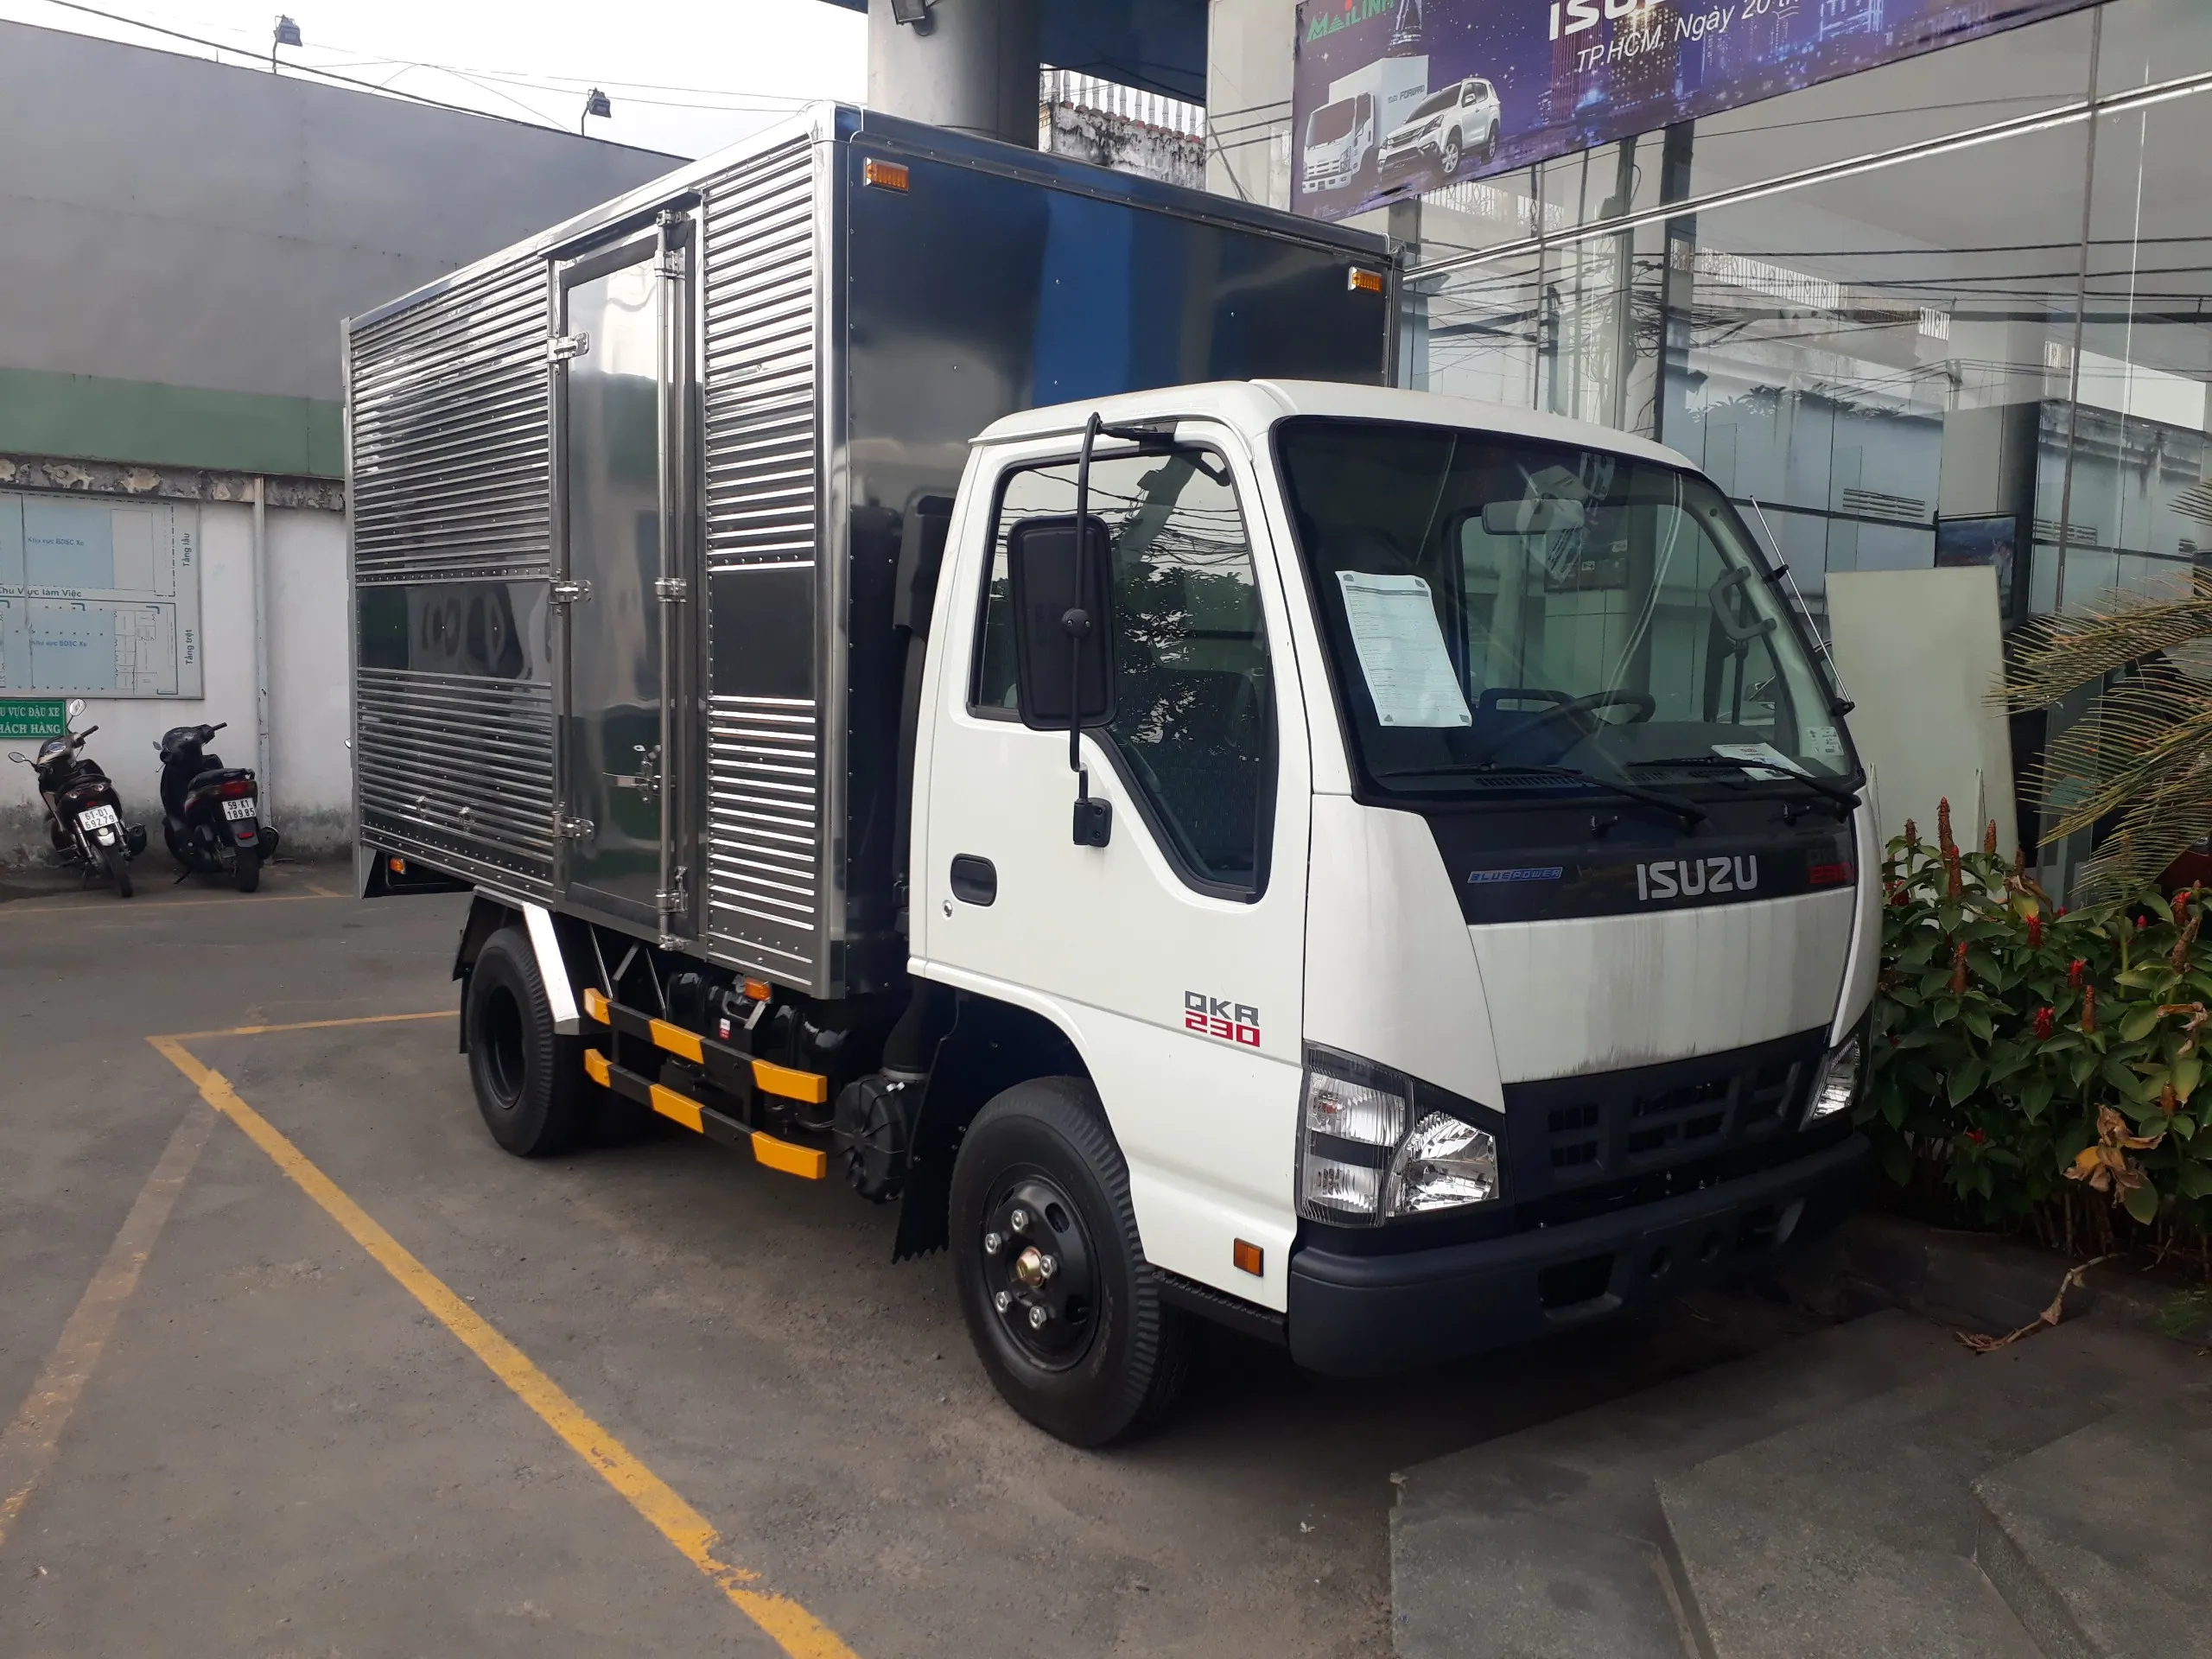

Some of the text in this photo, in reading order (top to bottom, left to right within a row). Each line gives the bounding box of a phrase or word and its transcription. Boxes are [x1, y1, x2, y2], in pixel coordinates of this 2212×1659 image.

[1675, 5, 1735, 41] Ngày
[48, 707, 60, 717] XE
[1637, 855, 1758, 900] ISUZU
[1185, 990, 1260, 1027] QKR
[1185, 1010, 1261, 1047] 230
